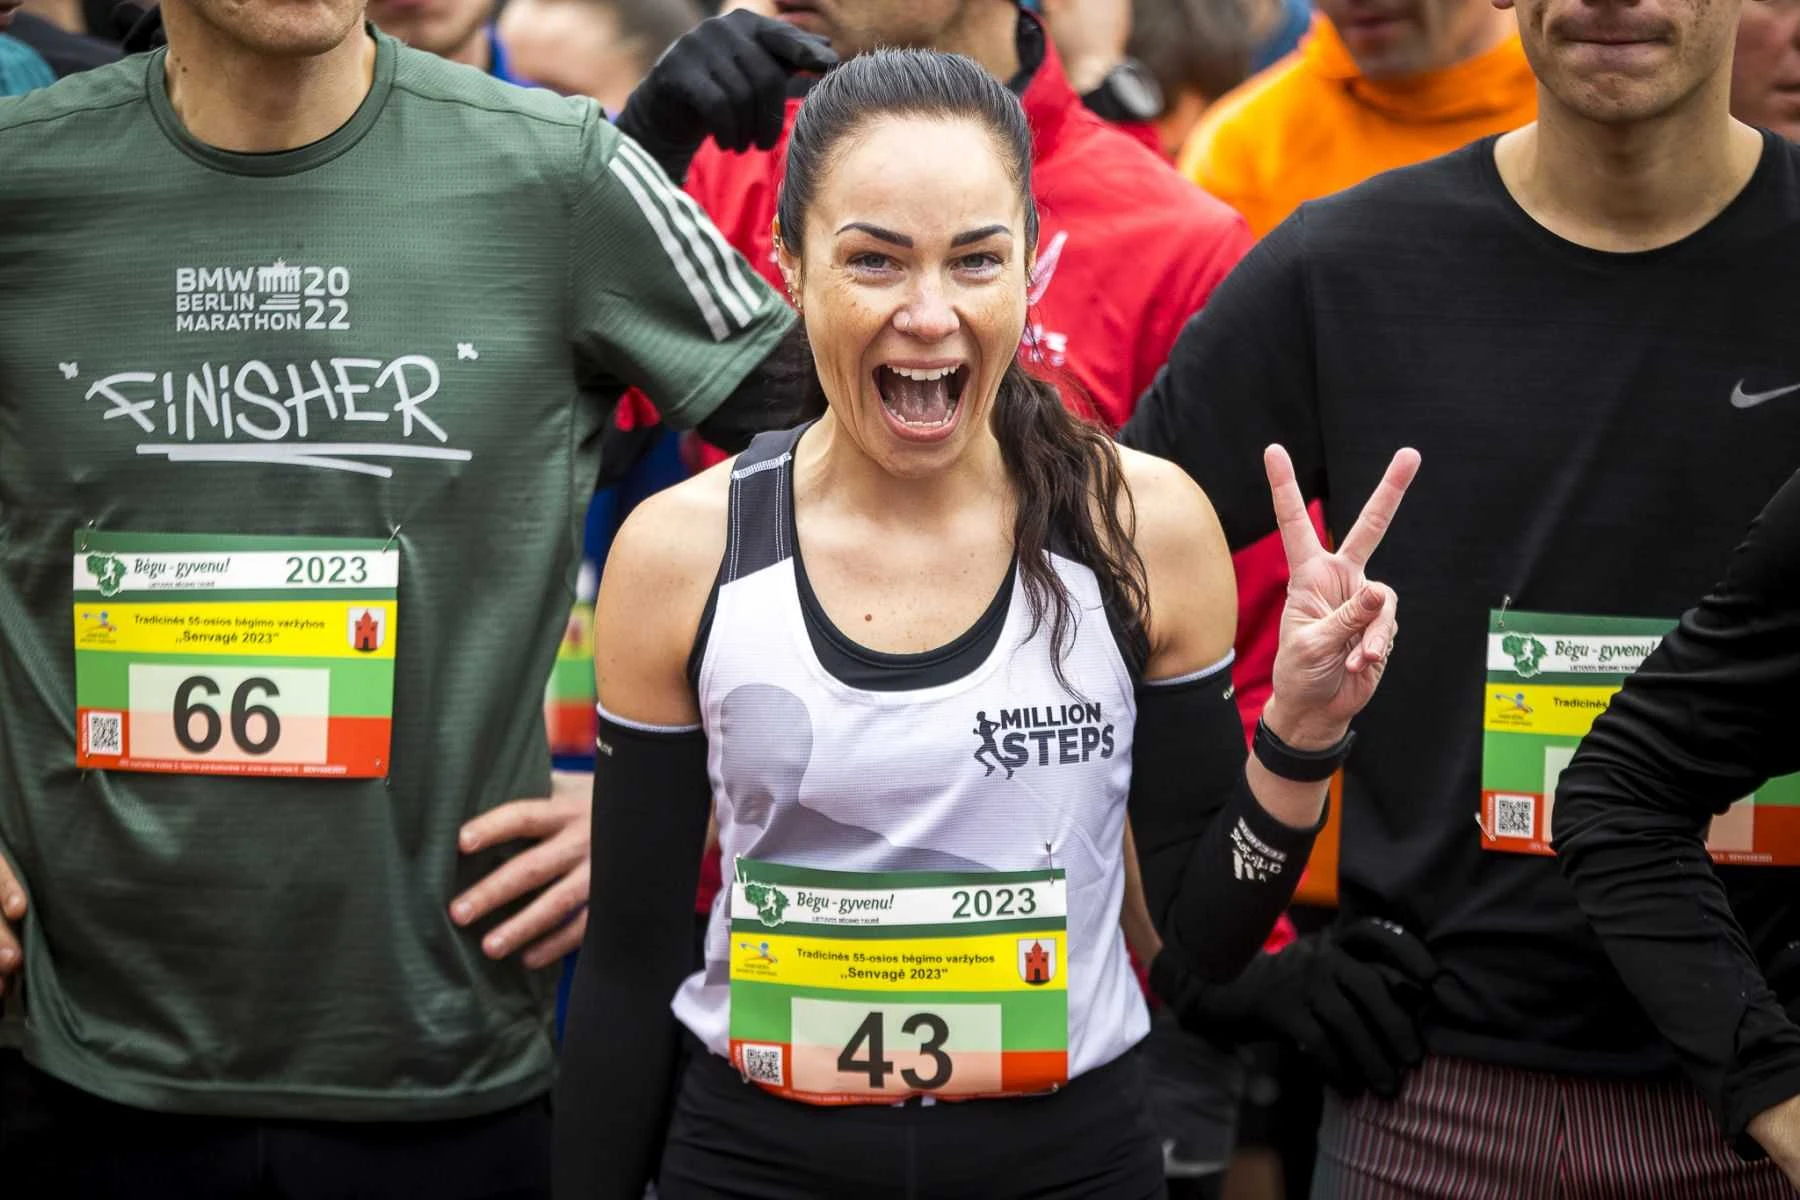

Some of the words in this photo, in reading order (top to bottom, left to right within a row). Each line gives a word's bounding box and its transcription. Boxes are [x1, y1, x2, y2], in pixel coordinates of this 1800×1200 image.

[176, 267, 254, 292] BMW
[304, 267, 350, 297] 20
[176, 293, 254, 311] BERLIN
[304, 298, 350, 330] 22
[176, 313, 300, 331] MARATHON
[175, 557, 231, 578] gyvenu!
[285, 556, 368, 584] 2023
[173, 675, 281, 756] 66
[1000, 702, 1101, 729] MILLION
[1553, 697, 1608, 710] Tradicinės
[1002, 724, 1114, 769] STEPS
[797, 892, 829, 912] Bėgu
[839, 893, 895, 915] gyvenu!
[952, 887, 1037, 919] 2023
[797, 948, 849, 962] Tradicinės
[853, 953, 899, 963] 55-osios
[902, 954, 943, 965] bėgimo
[945, 953, 996, 966] varžybos
[837, 1011, 953, 1090] 43
